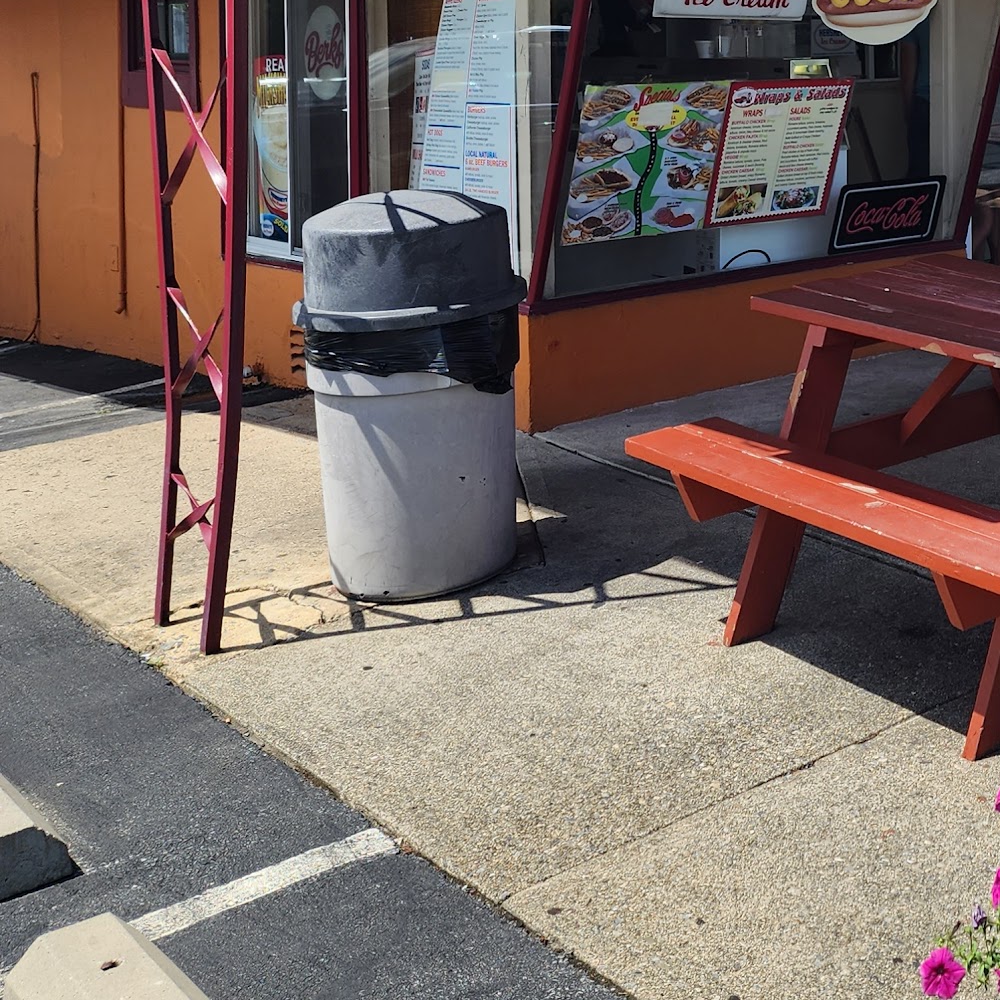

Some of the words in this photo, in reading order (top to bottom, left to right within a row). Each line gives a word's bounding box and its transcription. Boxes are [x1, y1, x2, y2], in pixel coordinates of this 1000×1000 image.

[305, 22, 344, 77] Berks
[806, 87, 847, 101] Salads
[743, 109, 764, 118] WRAPS
[790, 107, 811, 115] SALADS
